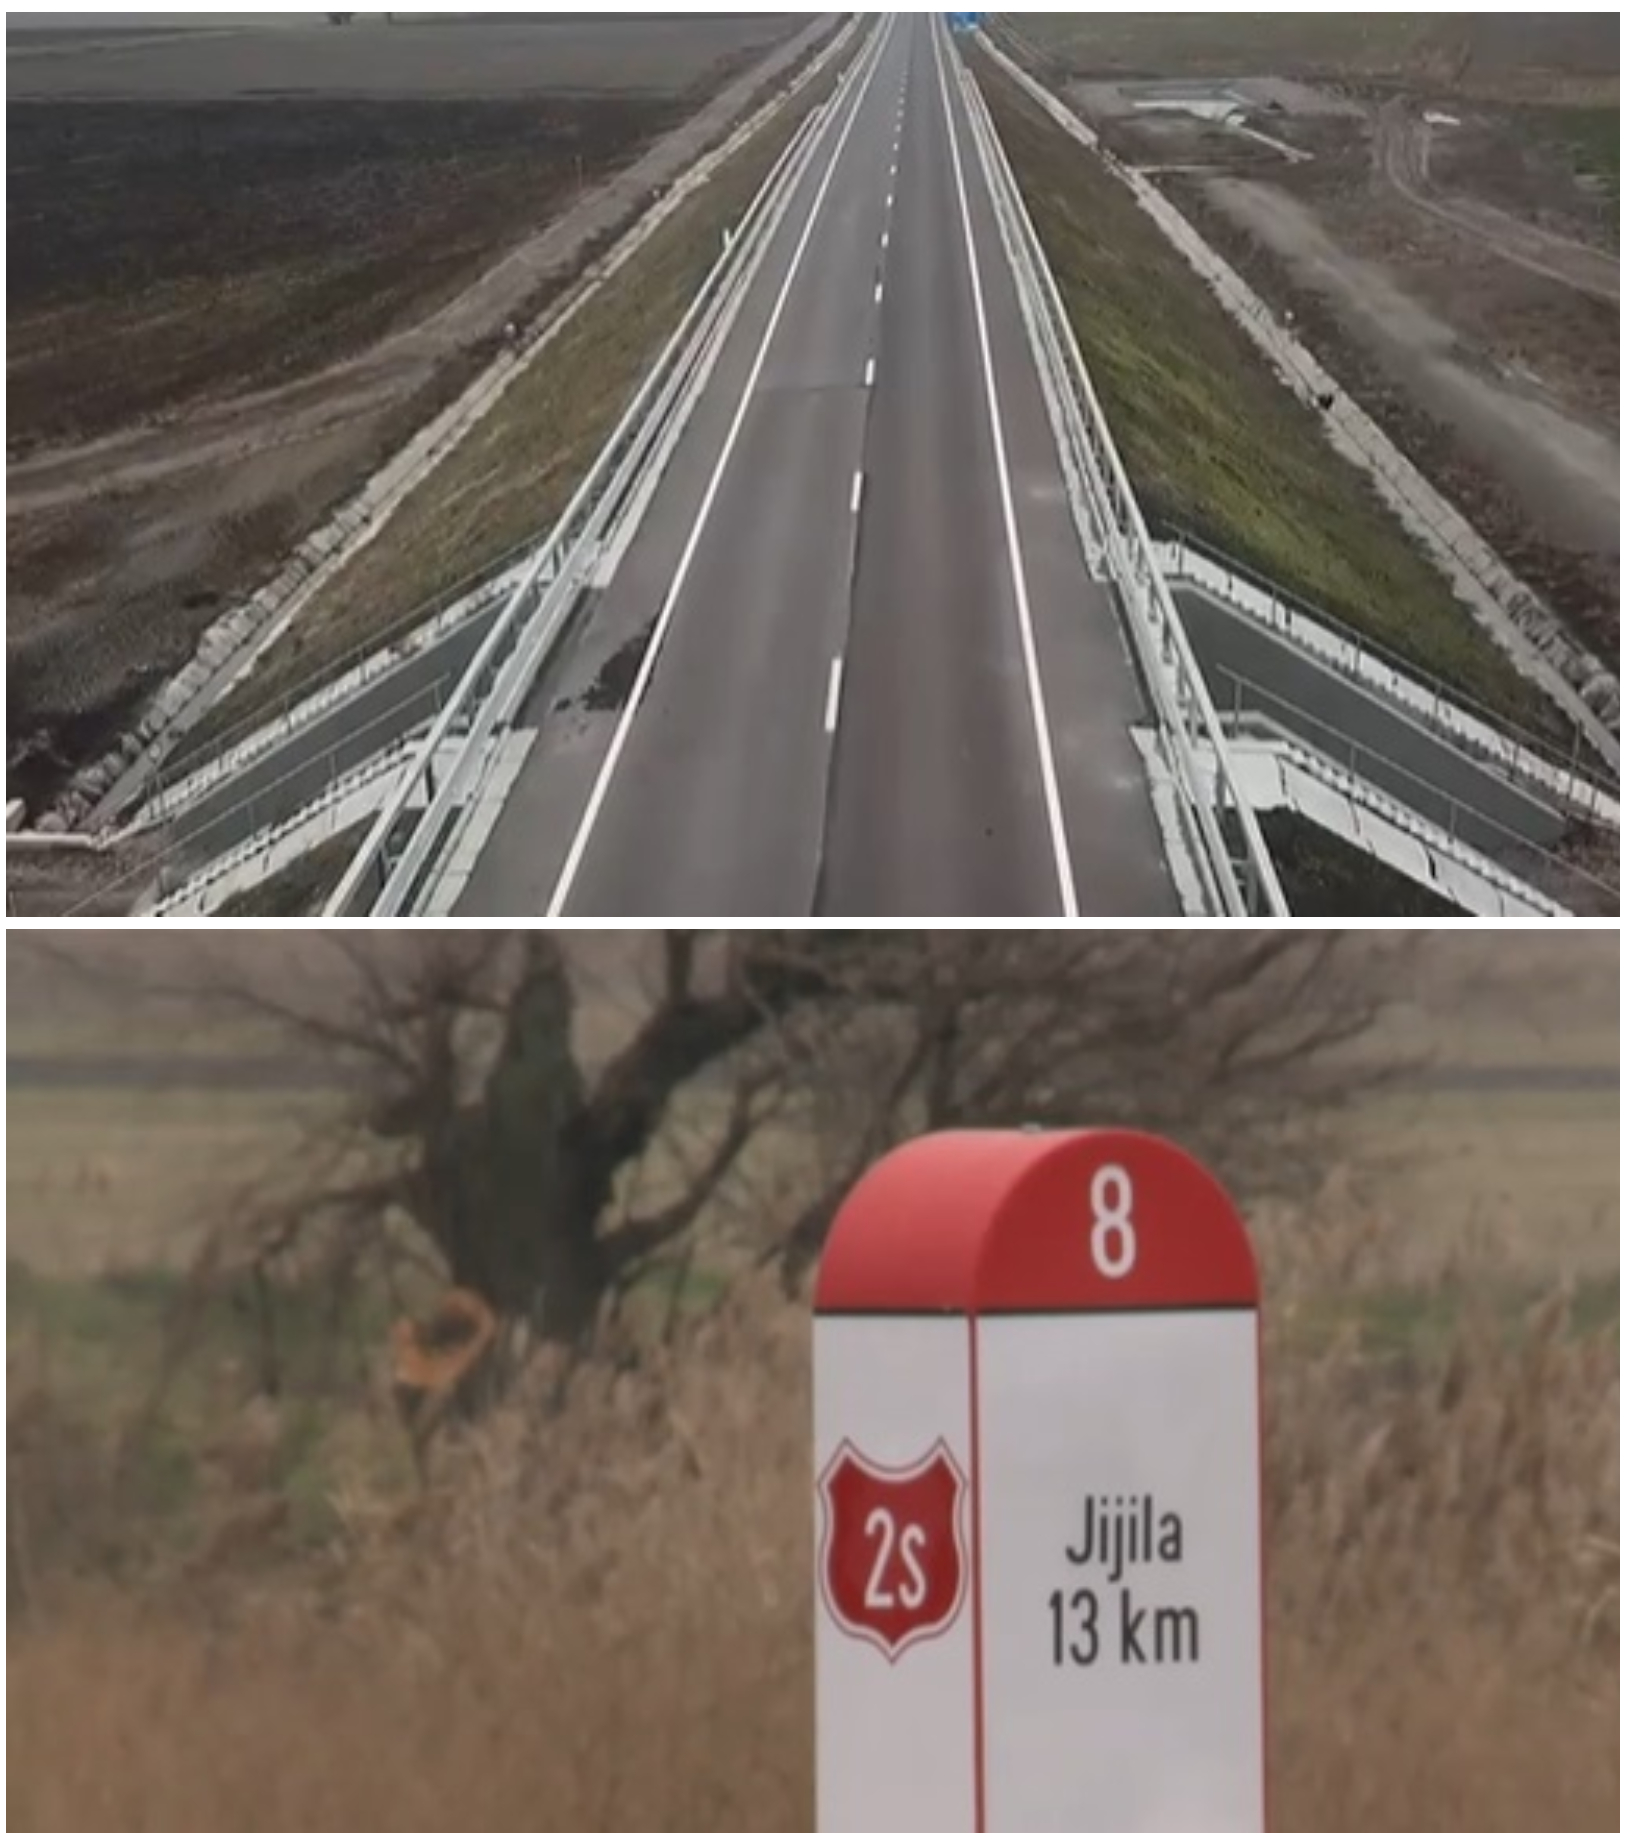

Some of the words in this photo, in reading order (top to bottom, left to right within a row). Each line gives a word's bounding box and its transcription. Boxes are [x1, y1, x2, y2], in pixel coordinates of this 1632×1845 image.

[1090, 1162, 1136, 1279] 8
[1066, 1495, 1183, 1583] Jijila
[1049, 1588, 1099, 1667] 13
[1121, 1588, 1199, 1664] km
